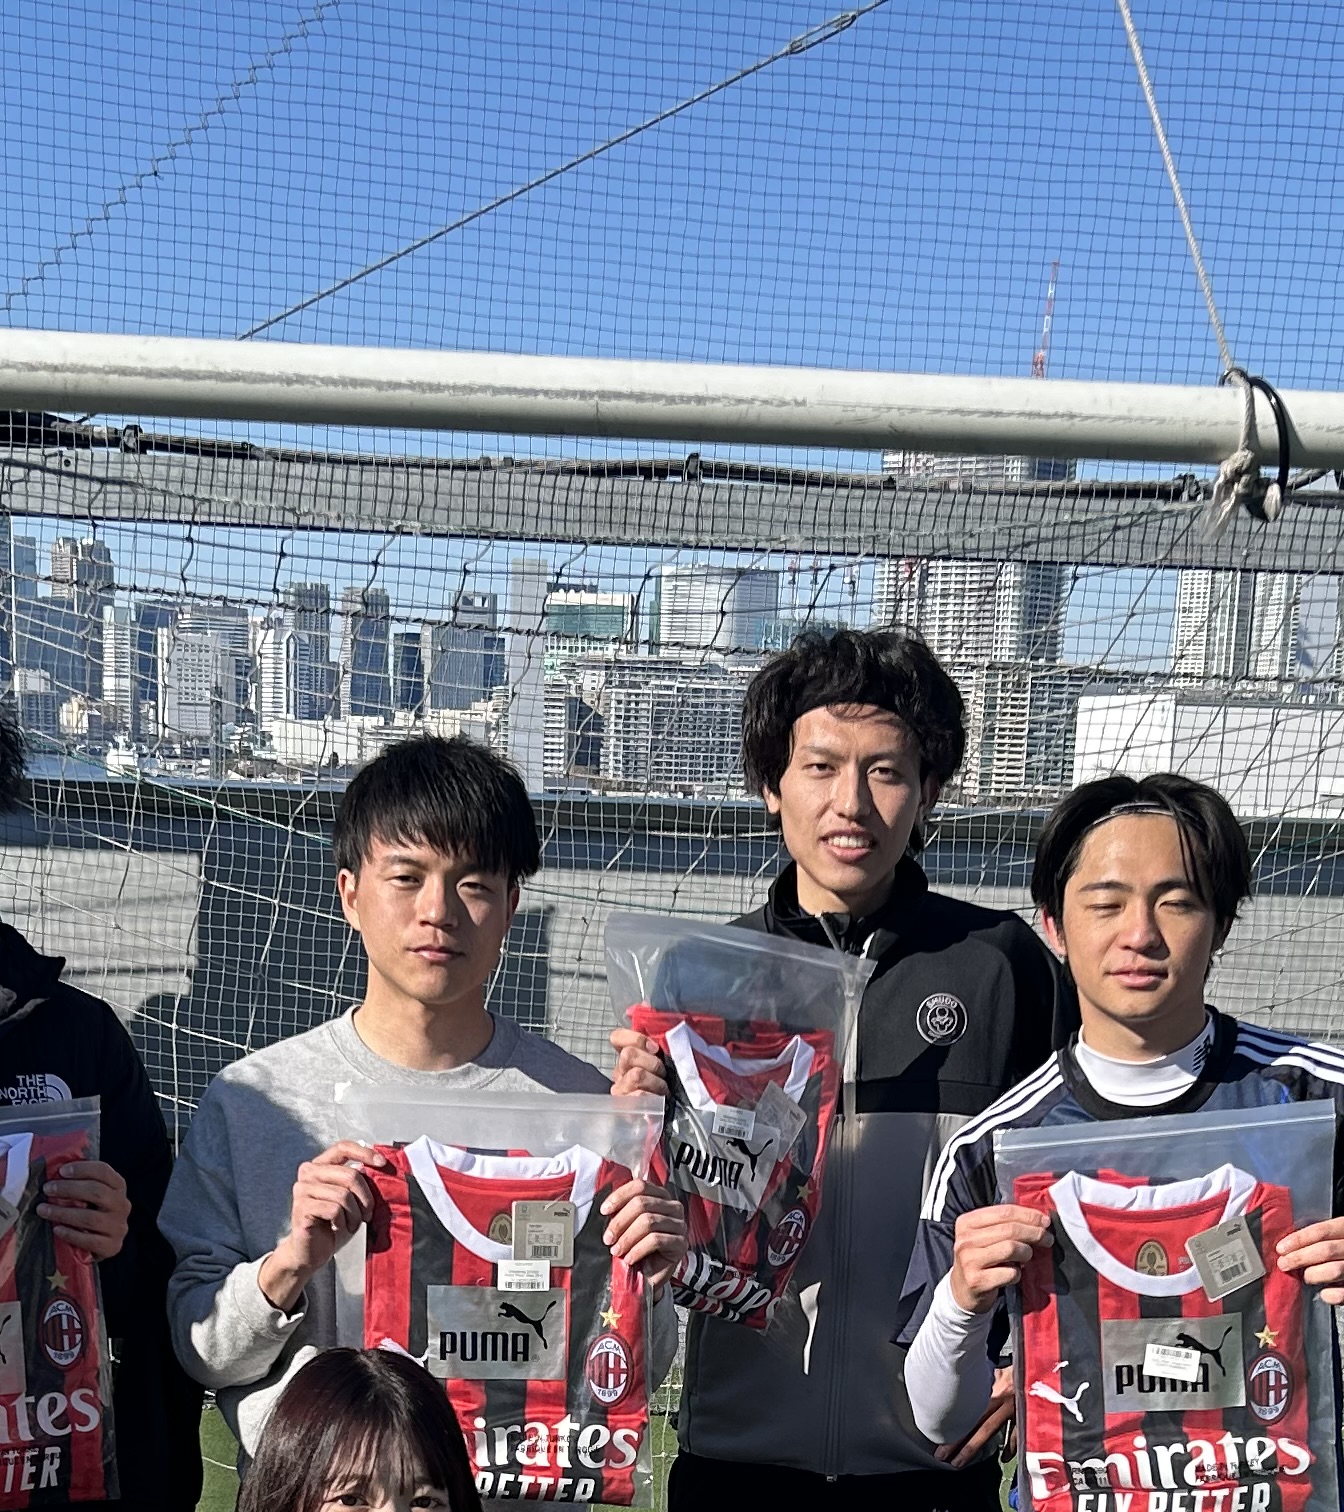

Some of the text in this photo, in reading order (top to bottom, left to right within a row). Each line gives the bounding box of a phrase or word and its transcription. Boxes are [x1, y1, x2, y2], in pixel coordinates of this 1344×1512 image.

[16, 1074, 46, 1087] THE
[674, 1142, 744, 1190] PUMA
[439, 1331, 531, 1362] PUMA
[596, 1340, 622, 1354] ACM
[1257, 1358, 1282, 1371] ACM
[464, 1414, 639, 1469] irates
[1026, 1431, 1311, 1500] Emirates
[475, 1471, 596, 1503] BETTER
